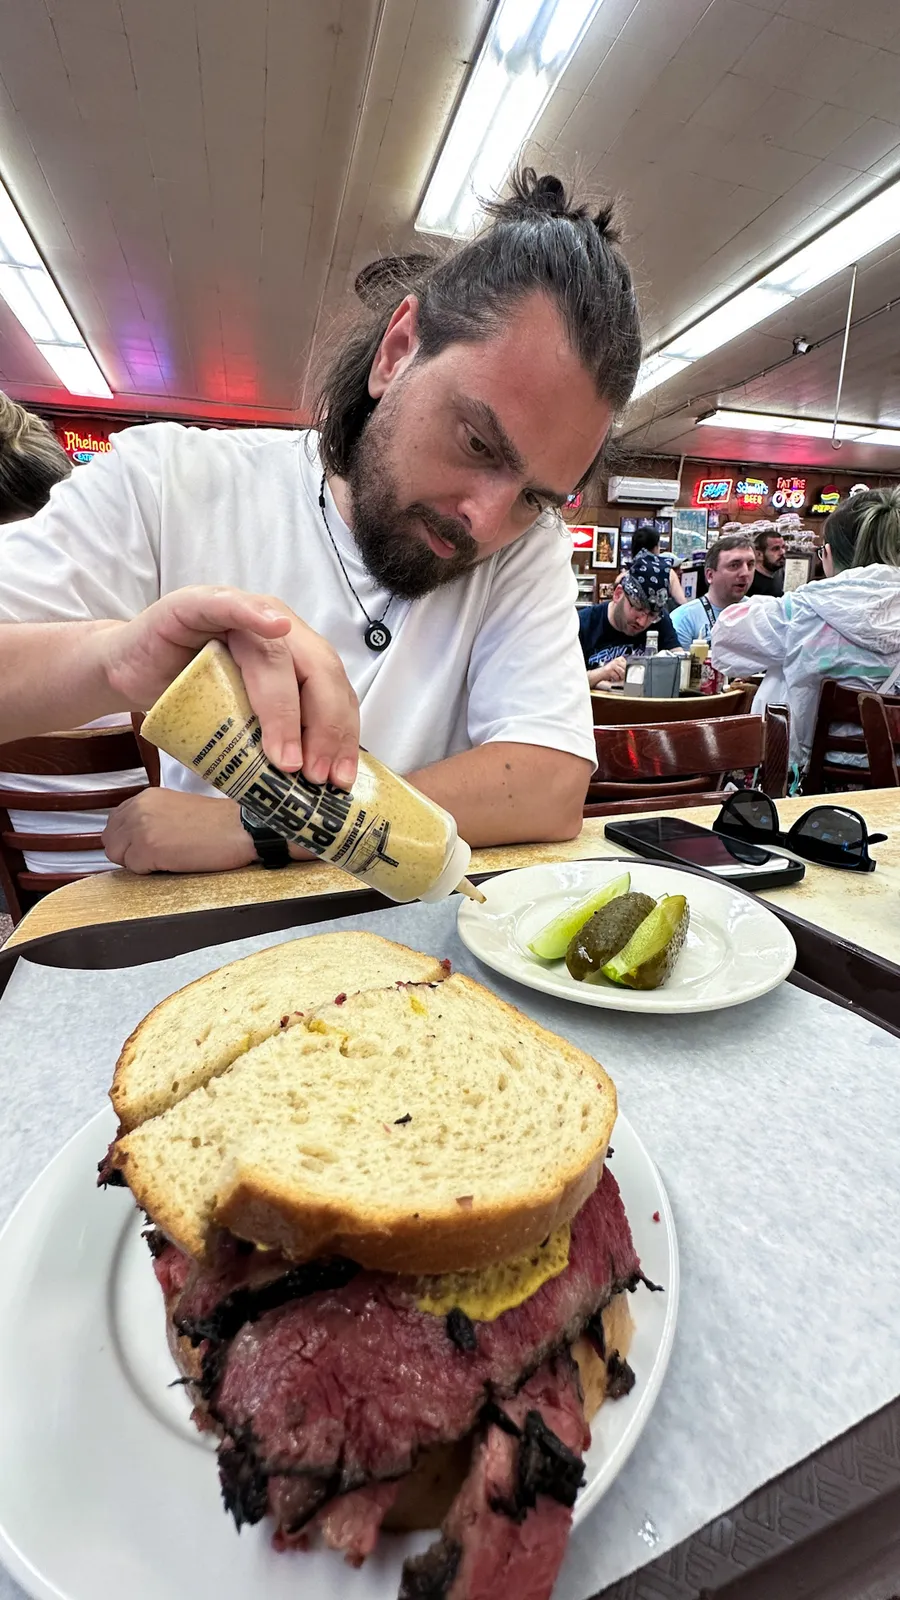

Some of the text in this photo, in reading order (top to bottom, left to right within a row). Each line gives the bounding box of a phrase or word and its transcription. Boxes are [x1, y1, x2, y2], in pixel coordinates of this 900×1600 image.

[64, 431, 112, 453] Rheingo
[776, 476, 791, 489] FAT
[744, 494, 763, 505] BEER
[192, 738, 217, 767] KATZSDELI
[237, 763, 295, 820] IVER
[265, 771, 323, 841] ATERE
[330, 826, 361, 863] DELICATESSEN
